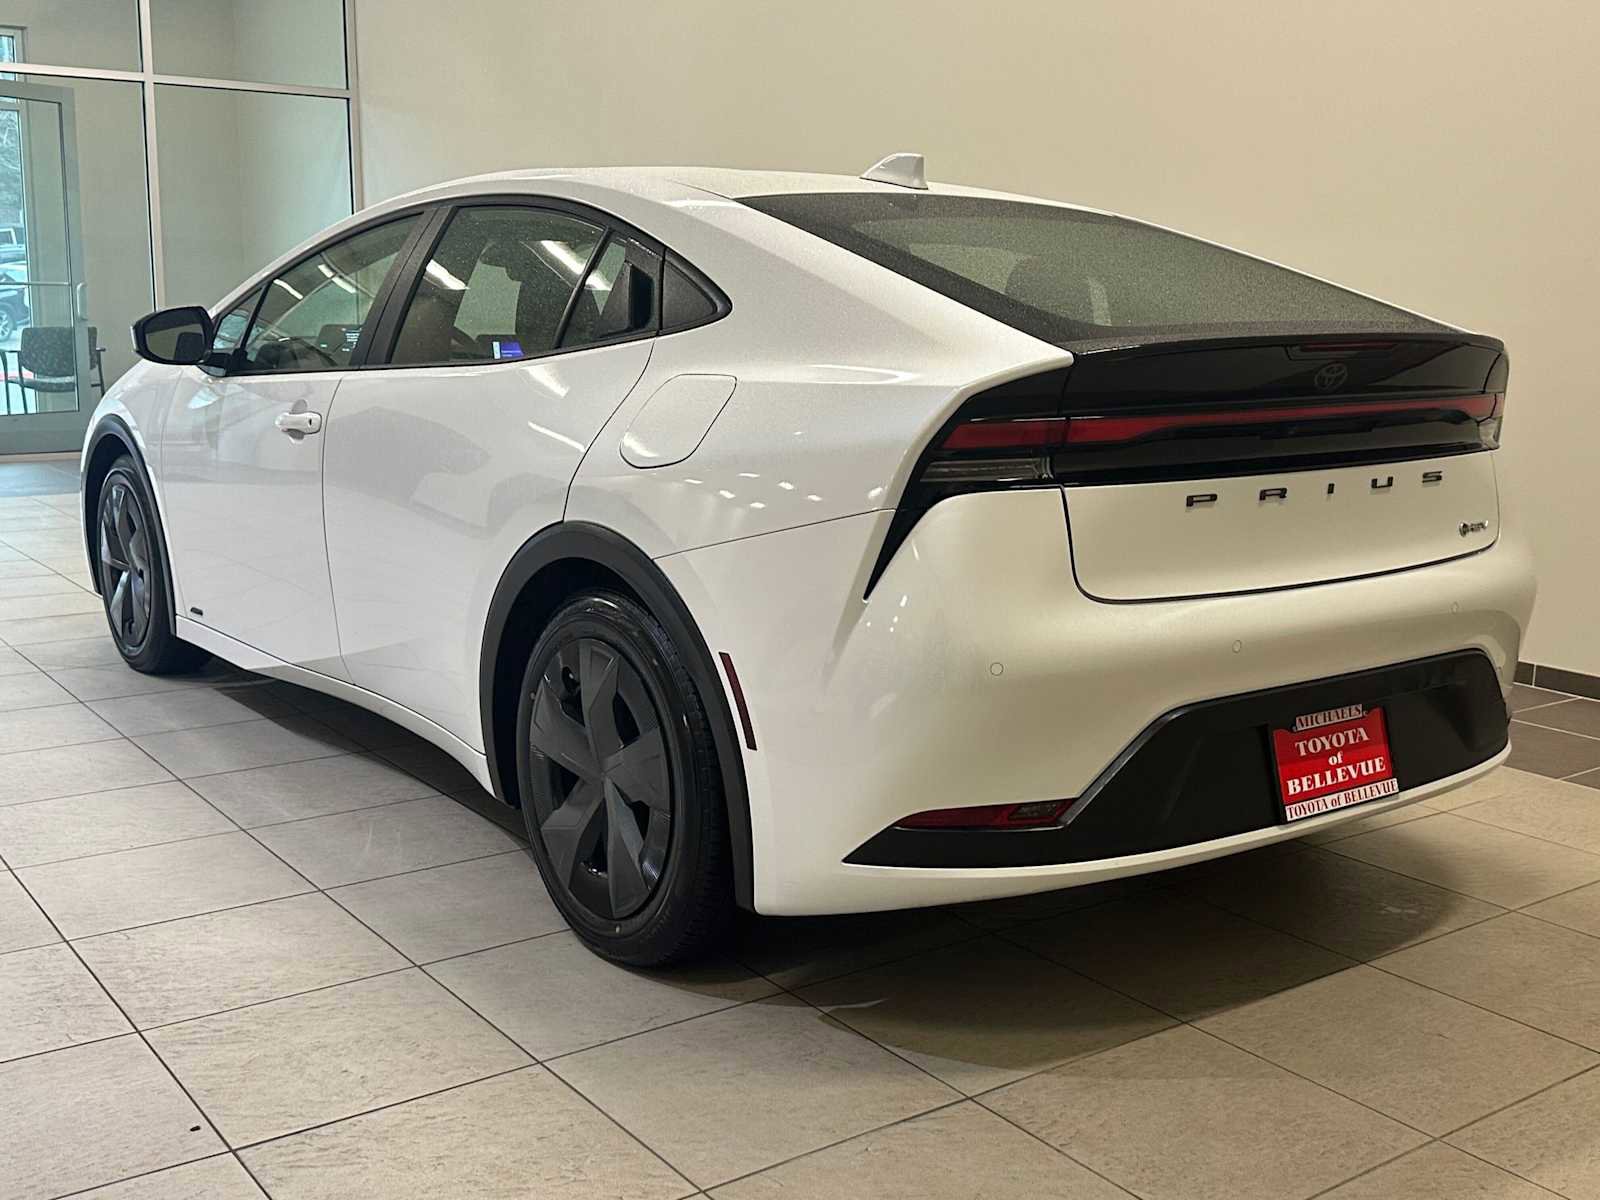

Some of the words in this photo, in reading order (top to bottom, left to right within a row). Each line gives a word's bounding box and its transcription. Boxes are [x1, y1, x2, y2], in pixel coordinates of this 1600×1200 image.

[1186, 471, 1442, 507] PRIUS
[1297, 706, 1362, 730] MICHAELS
[1295, 727, 1369, 757] TOYOTA
[1328, 751, 1343, 766] of
[1286, 757, 1386, 795] BELLEVUE
[1286, 801, 1329, 820] TOYOTA
[1330, 795, 1342, 807] of
[1344, 779, 1397, 802] BELLEVUE
